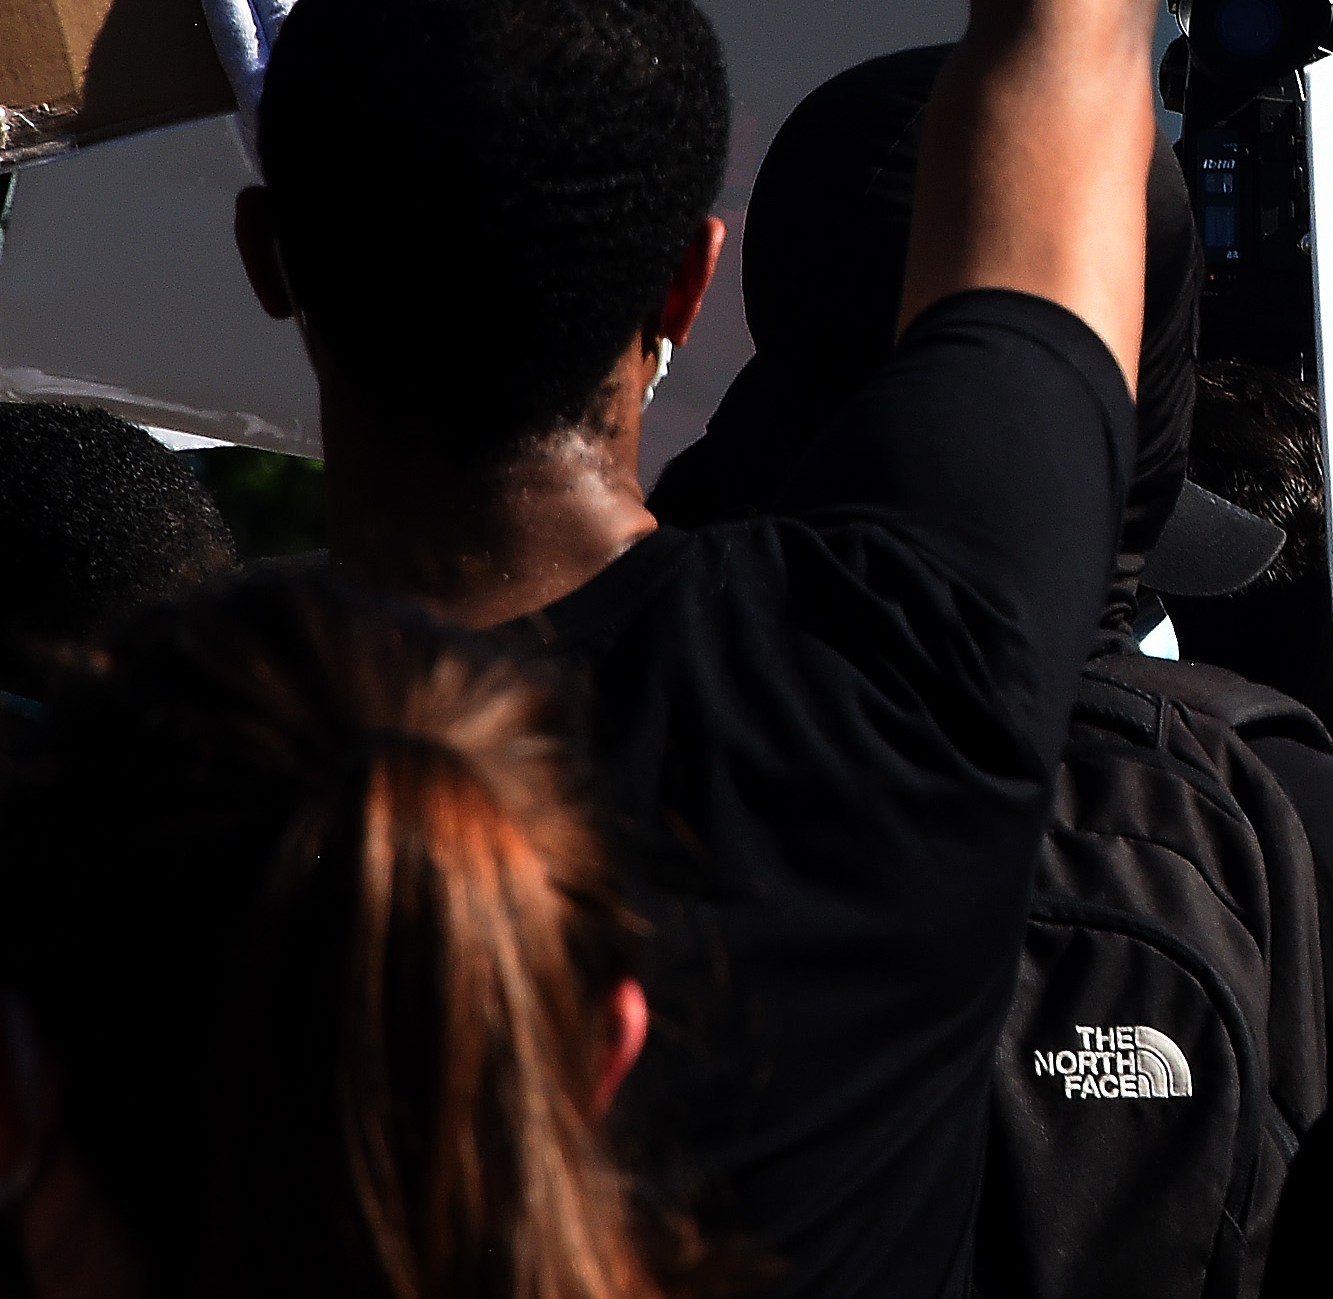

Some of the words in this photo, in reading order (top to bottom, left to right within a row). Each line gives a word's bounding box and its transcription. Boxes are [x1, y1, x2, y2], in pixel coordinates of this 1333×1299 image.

[1076, 1025, 1135, 1051] THE
[1034, 1050, 1136, 1076] NORTH
[1065, 1074, 1139, 1099] FACE
